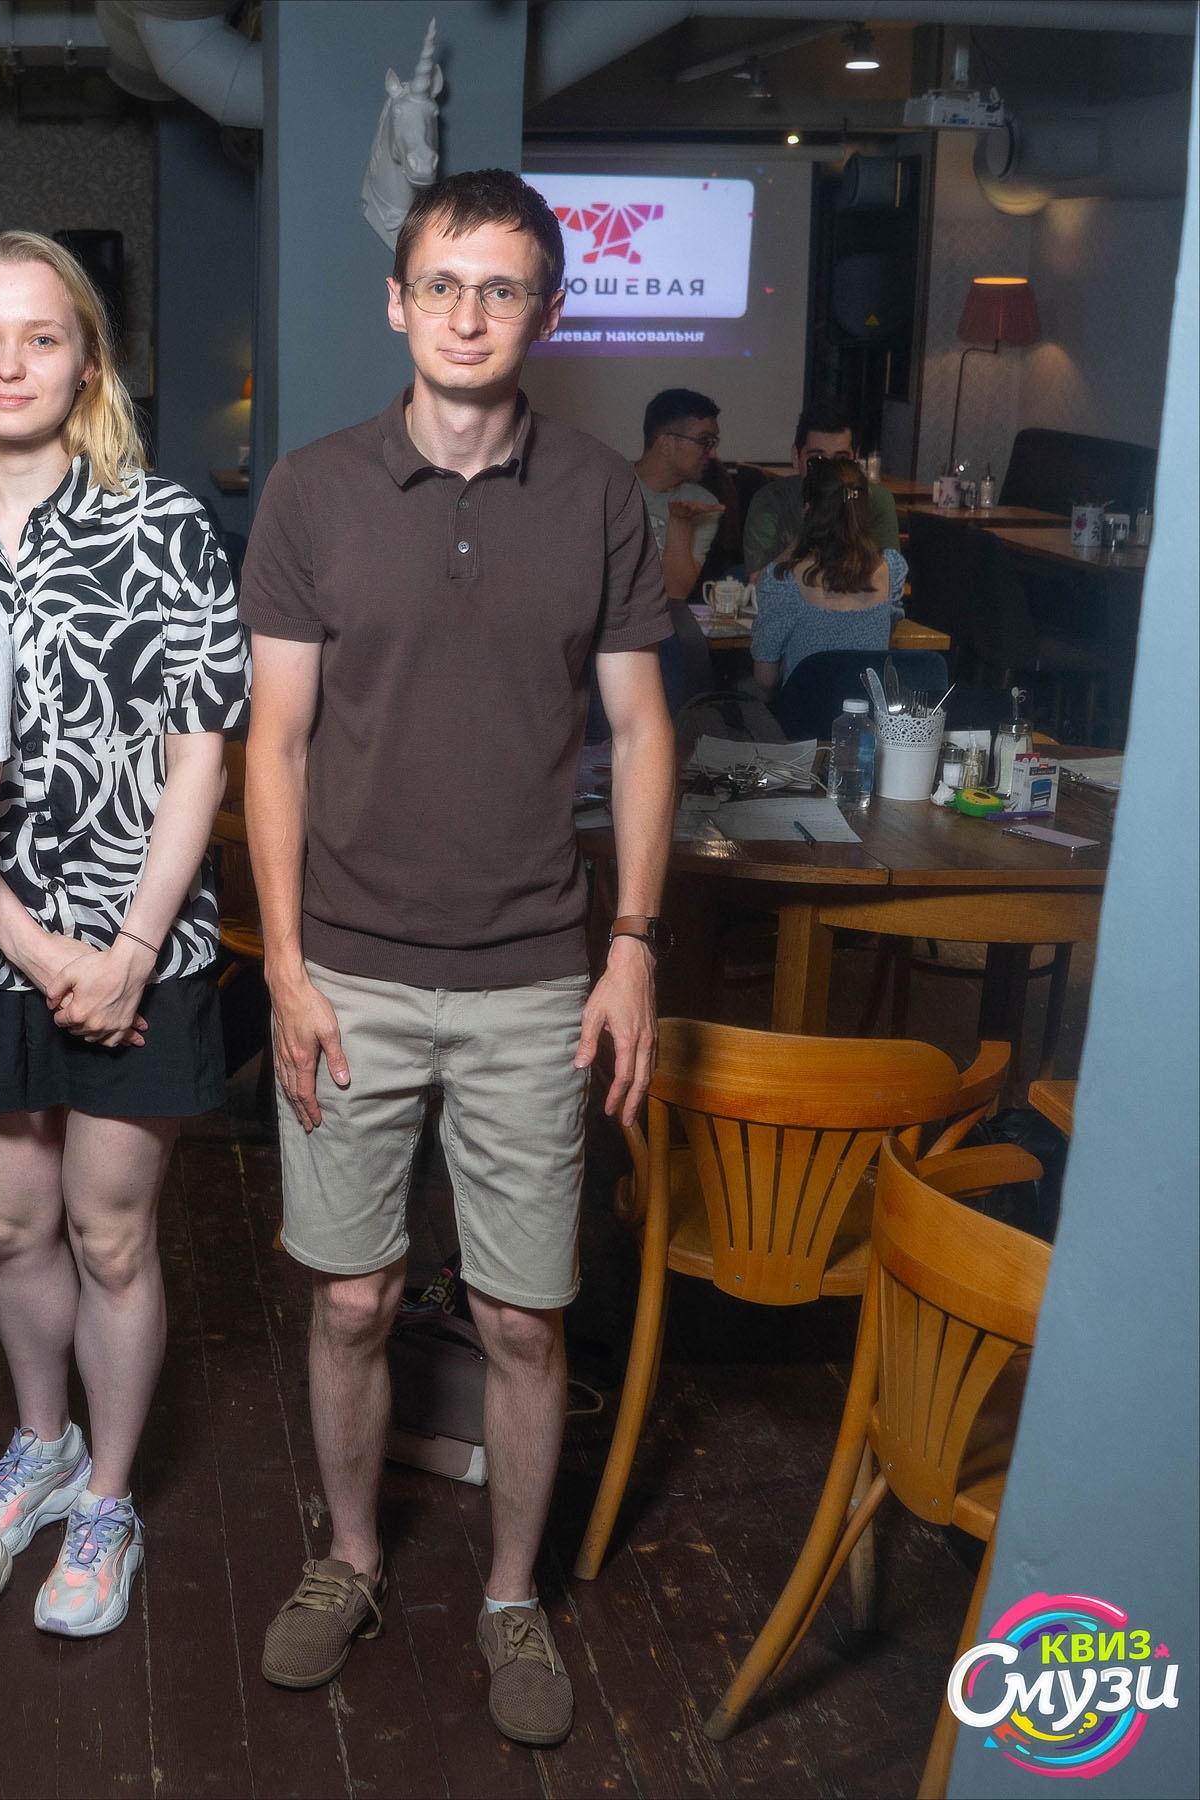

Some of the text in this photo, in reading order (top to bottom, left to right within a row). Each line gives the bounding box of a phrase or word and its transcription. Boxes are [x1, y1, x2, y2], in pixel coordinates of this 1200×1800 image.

[564, 277, 705, 297] ЮШЕВАЯ
[550, 331, 705, 342] шевая наковальня
